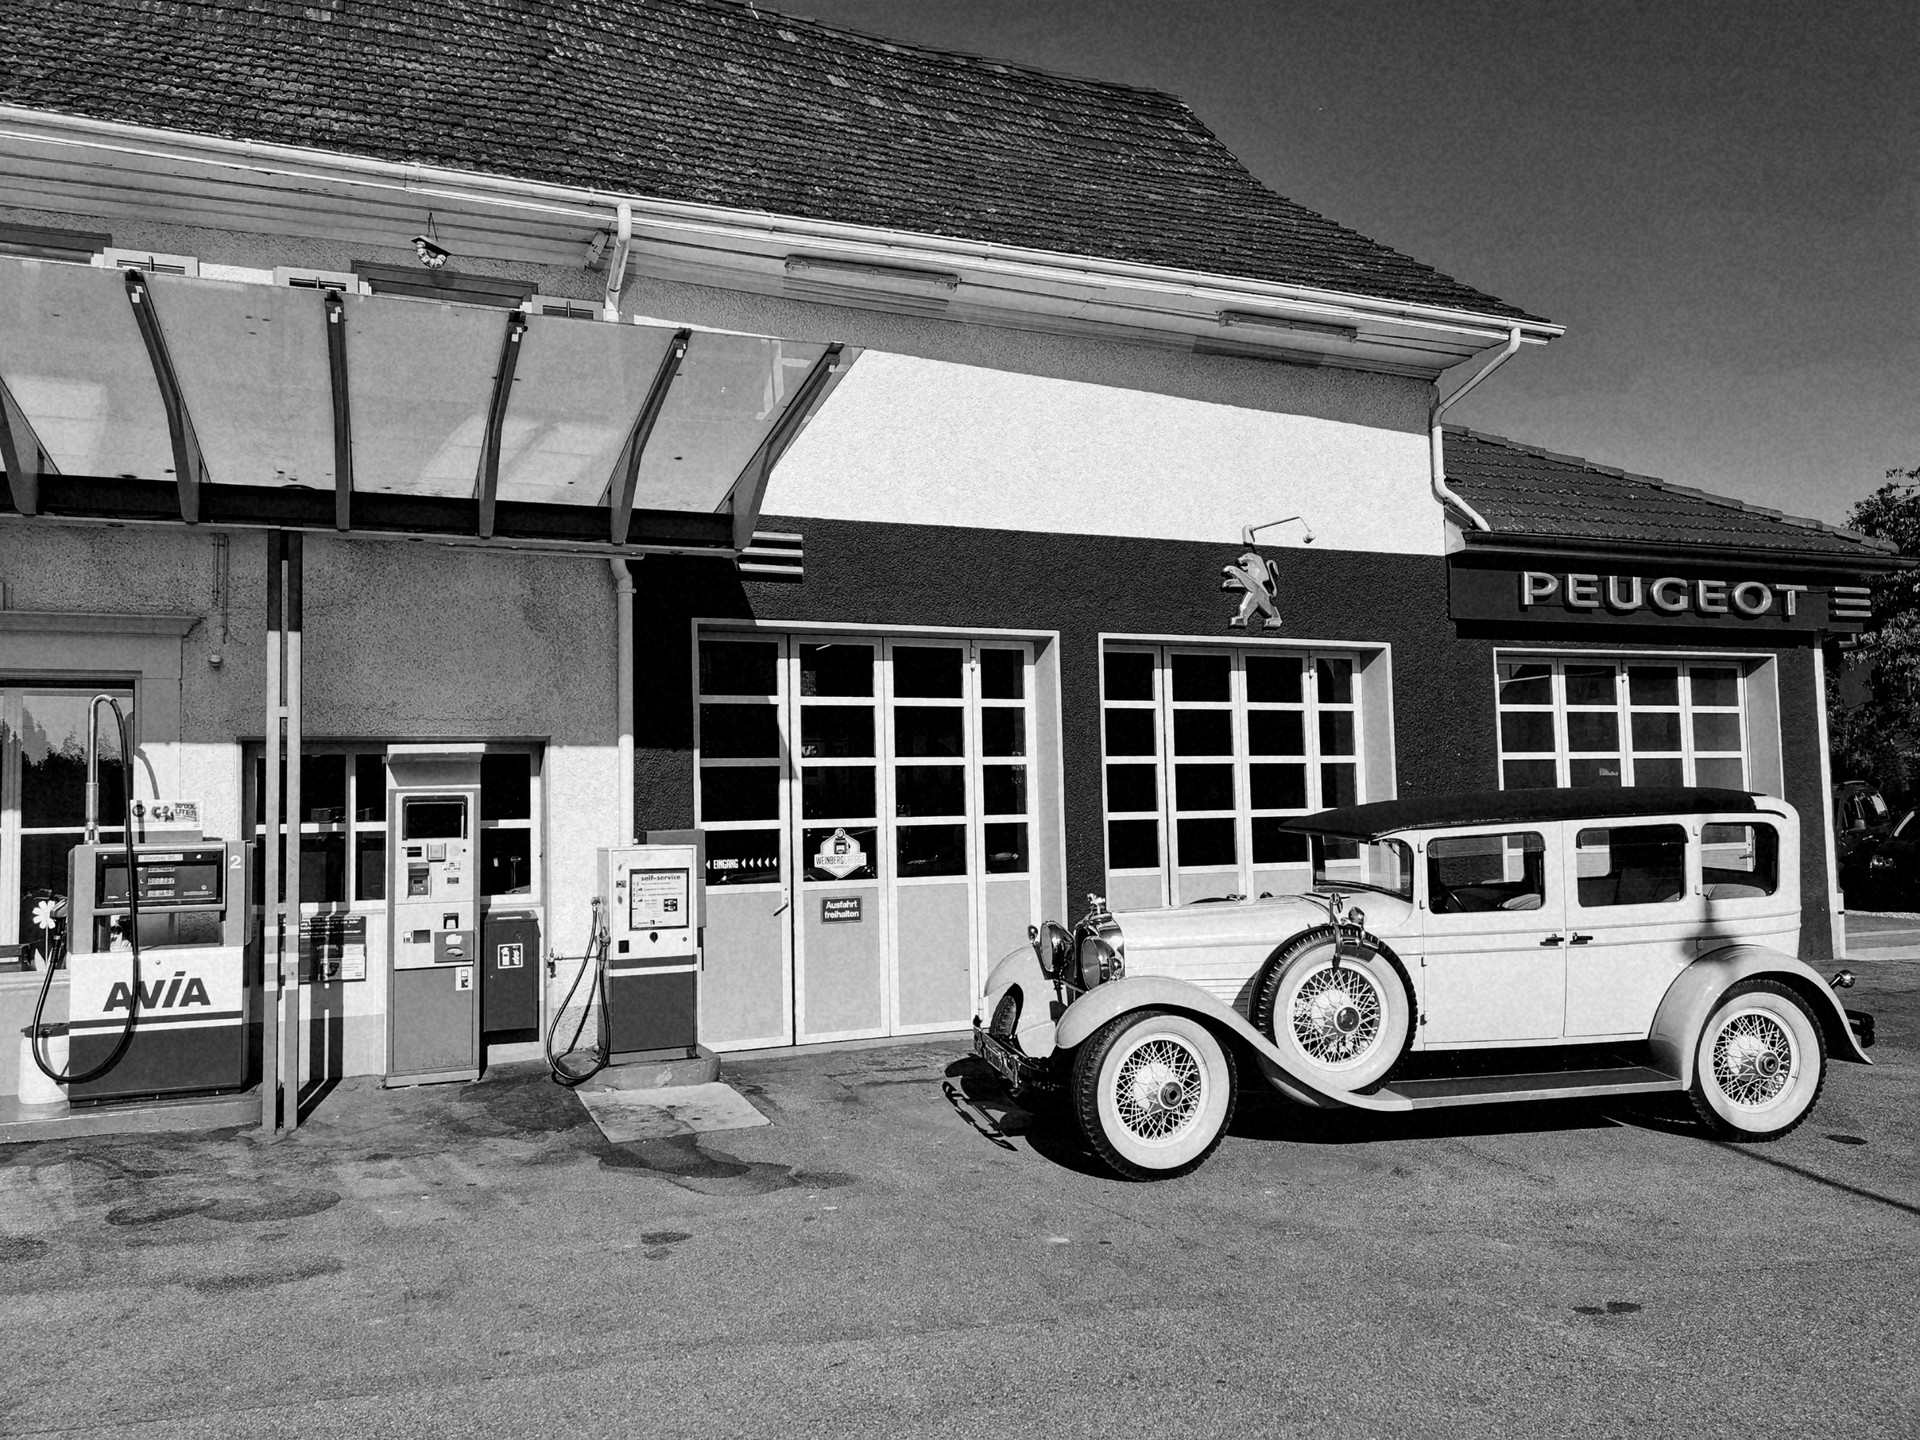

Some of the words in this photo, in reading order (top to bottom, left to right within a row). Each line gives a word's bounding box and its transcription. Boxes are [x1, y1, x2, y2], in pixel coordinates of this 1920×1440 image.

[1521, 570, 1808, 616] PEUGEOT
[229, 855, 242, 869] 2
[713, 858, 739, 869] EINGANG
[825, 900, 858, 909] Ausfahrt
[824, 910, 860, 919] freihalten
